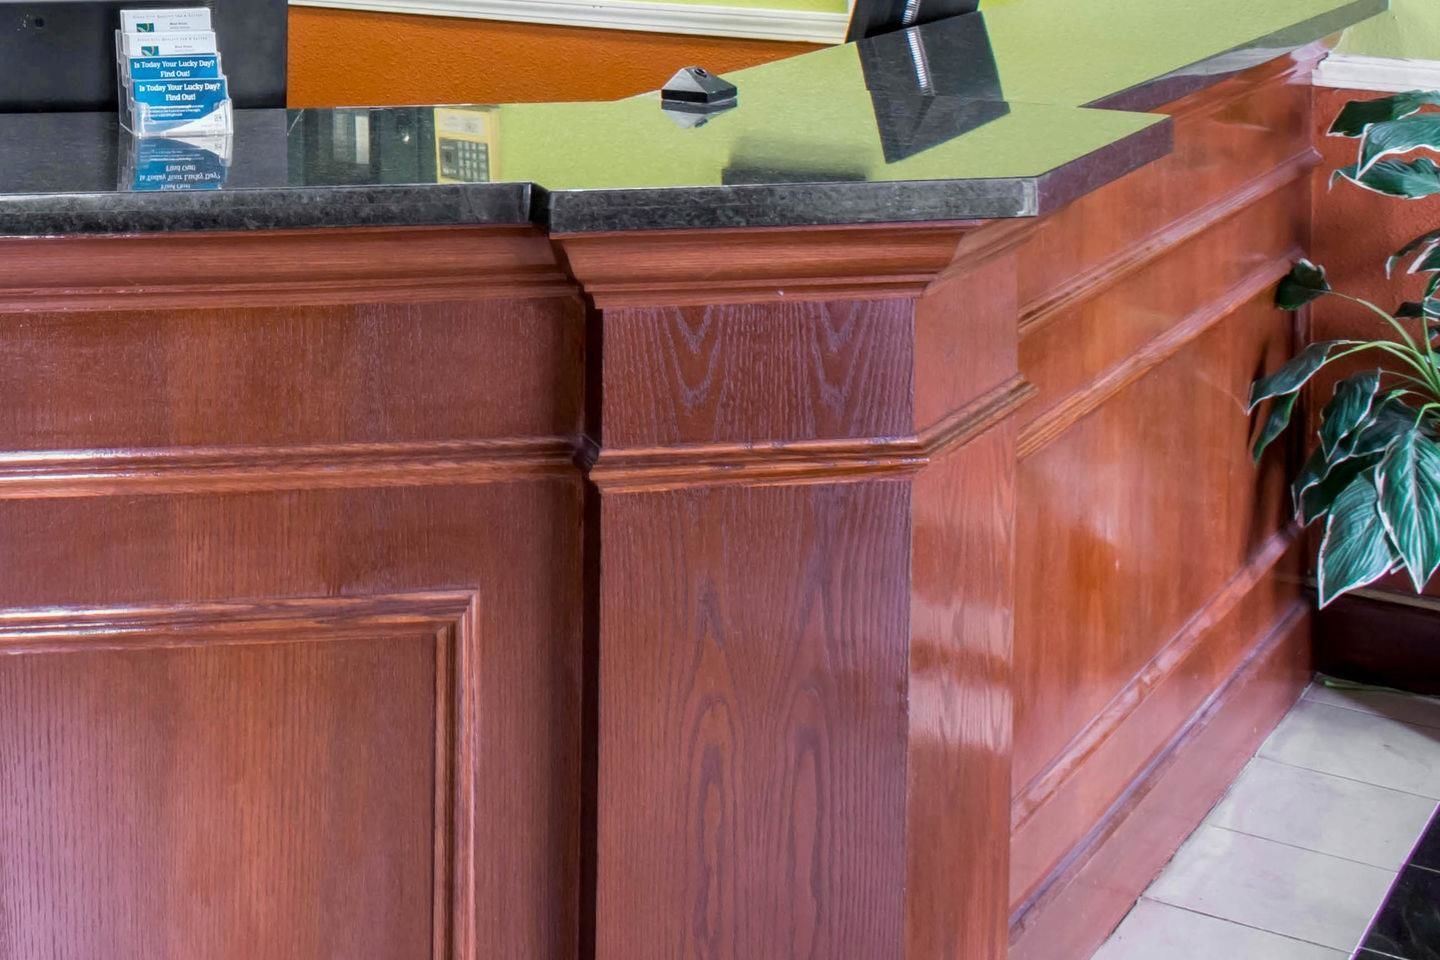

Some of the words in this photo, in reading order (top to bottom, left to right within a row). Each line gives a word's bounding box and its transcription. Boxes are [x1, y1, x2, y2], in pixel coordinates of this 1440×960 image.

[141, 61, 161, 69] Today
[162, 60, 177, 68] Your
[179, 60, 198, 68] Lucky
[199, 60, 215, 68] Day?
[160, 70, 175, 78] Find
[147, 84, 166, 92] Today
[167, 83, 182, 91] Your
[184, 83, 204, 91] Lucky
[204, 83, 221, 91] Day?
[182, 93, 196, 101] Out!
